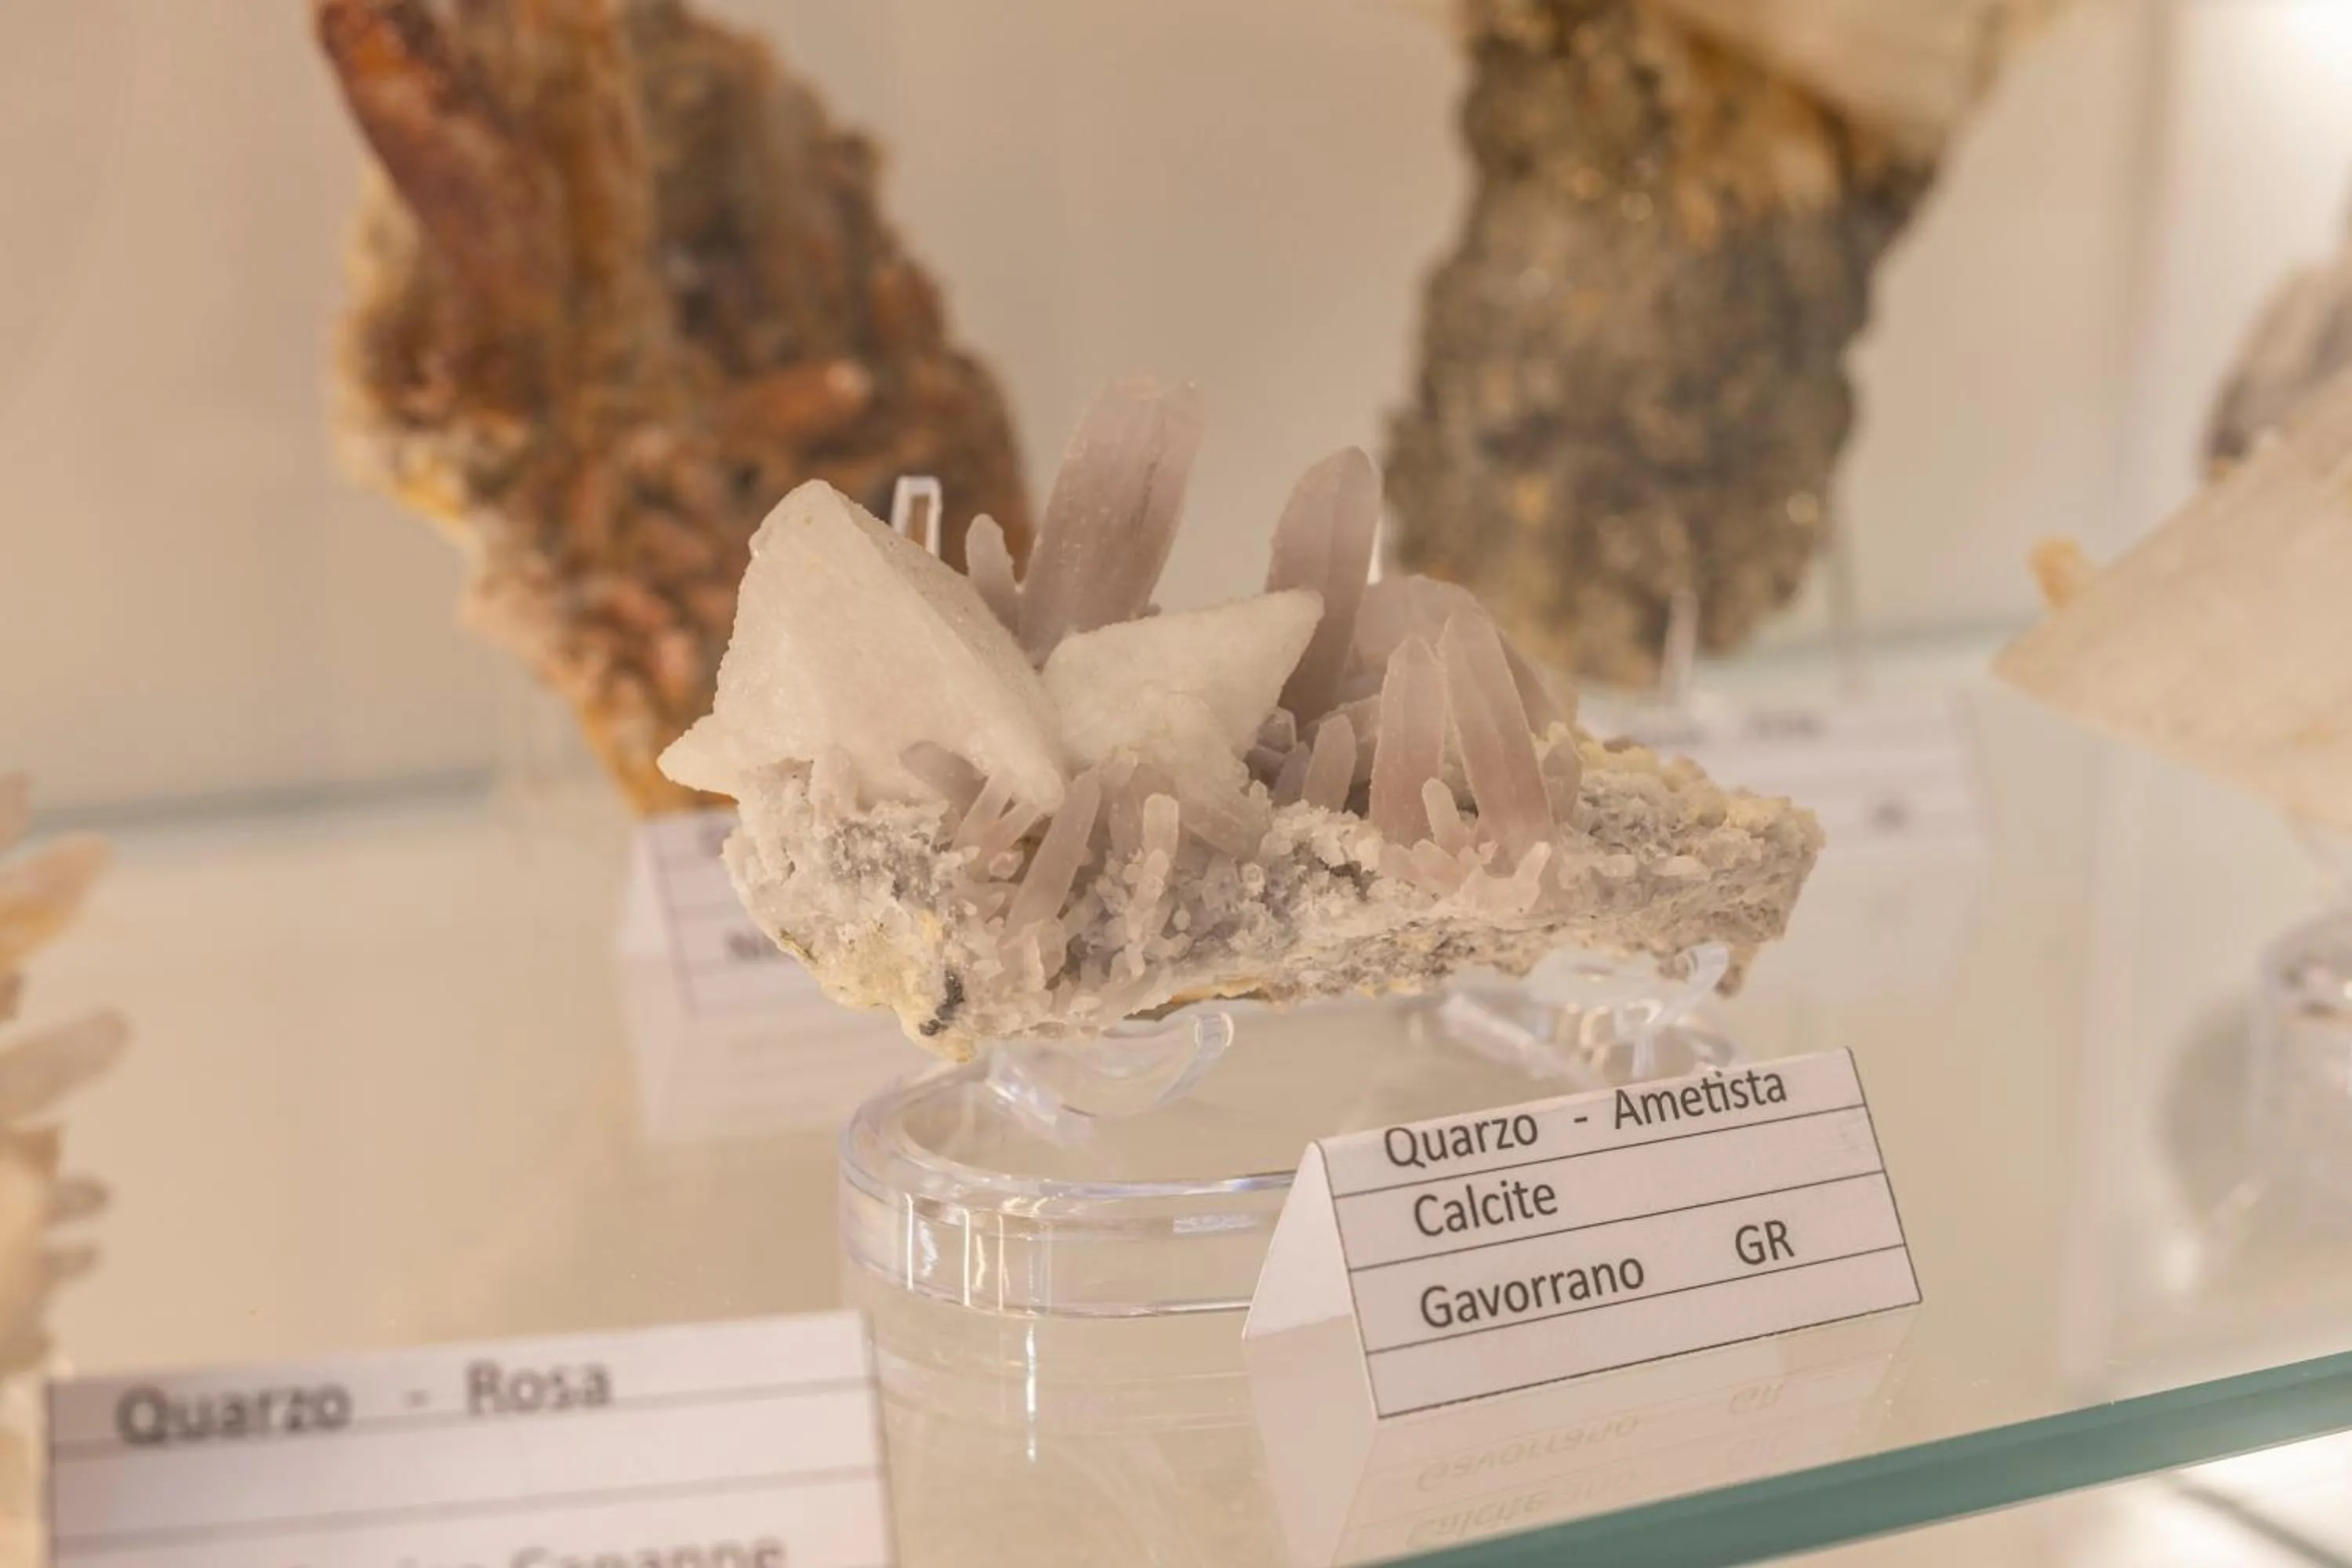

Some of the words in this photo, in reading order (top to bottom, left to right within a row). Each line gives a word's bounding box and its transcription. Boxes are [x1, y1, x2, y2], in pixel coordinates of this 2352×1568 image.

[1384, 1114, 1538, 1169] Quarzo
[1614, 1069, 1788, 1130] Ametista
[1414, 1179, 1558, 1237] Calcite
[1420, 1258, 1644, 1329] Gavorrano
[1735, 1219, 1795, 1266] GR
[116, 1381, 353, 1446] Quarzo
[466, 1359, 612, 1417] Rosa
